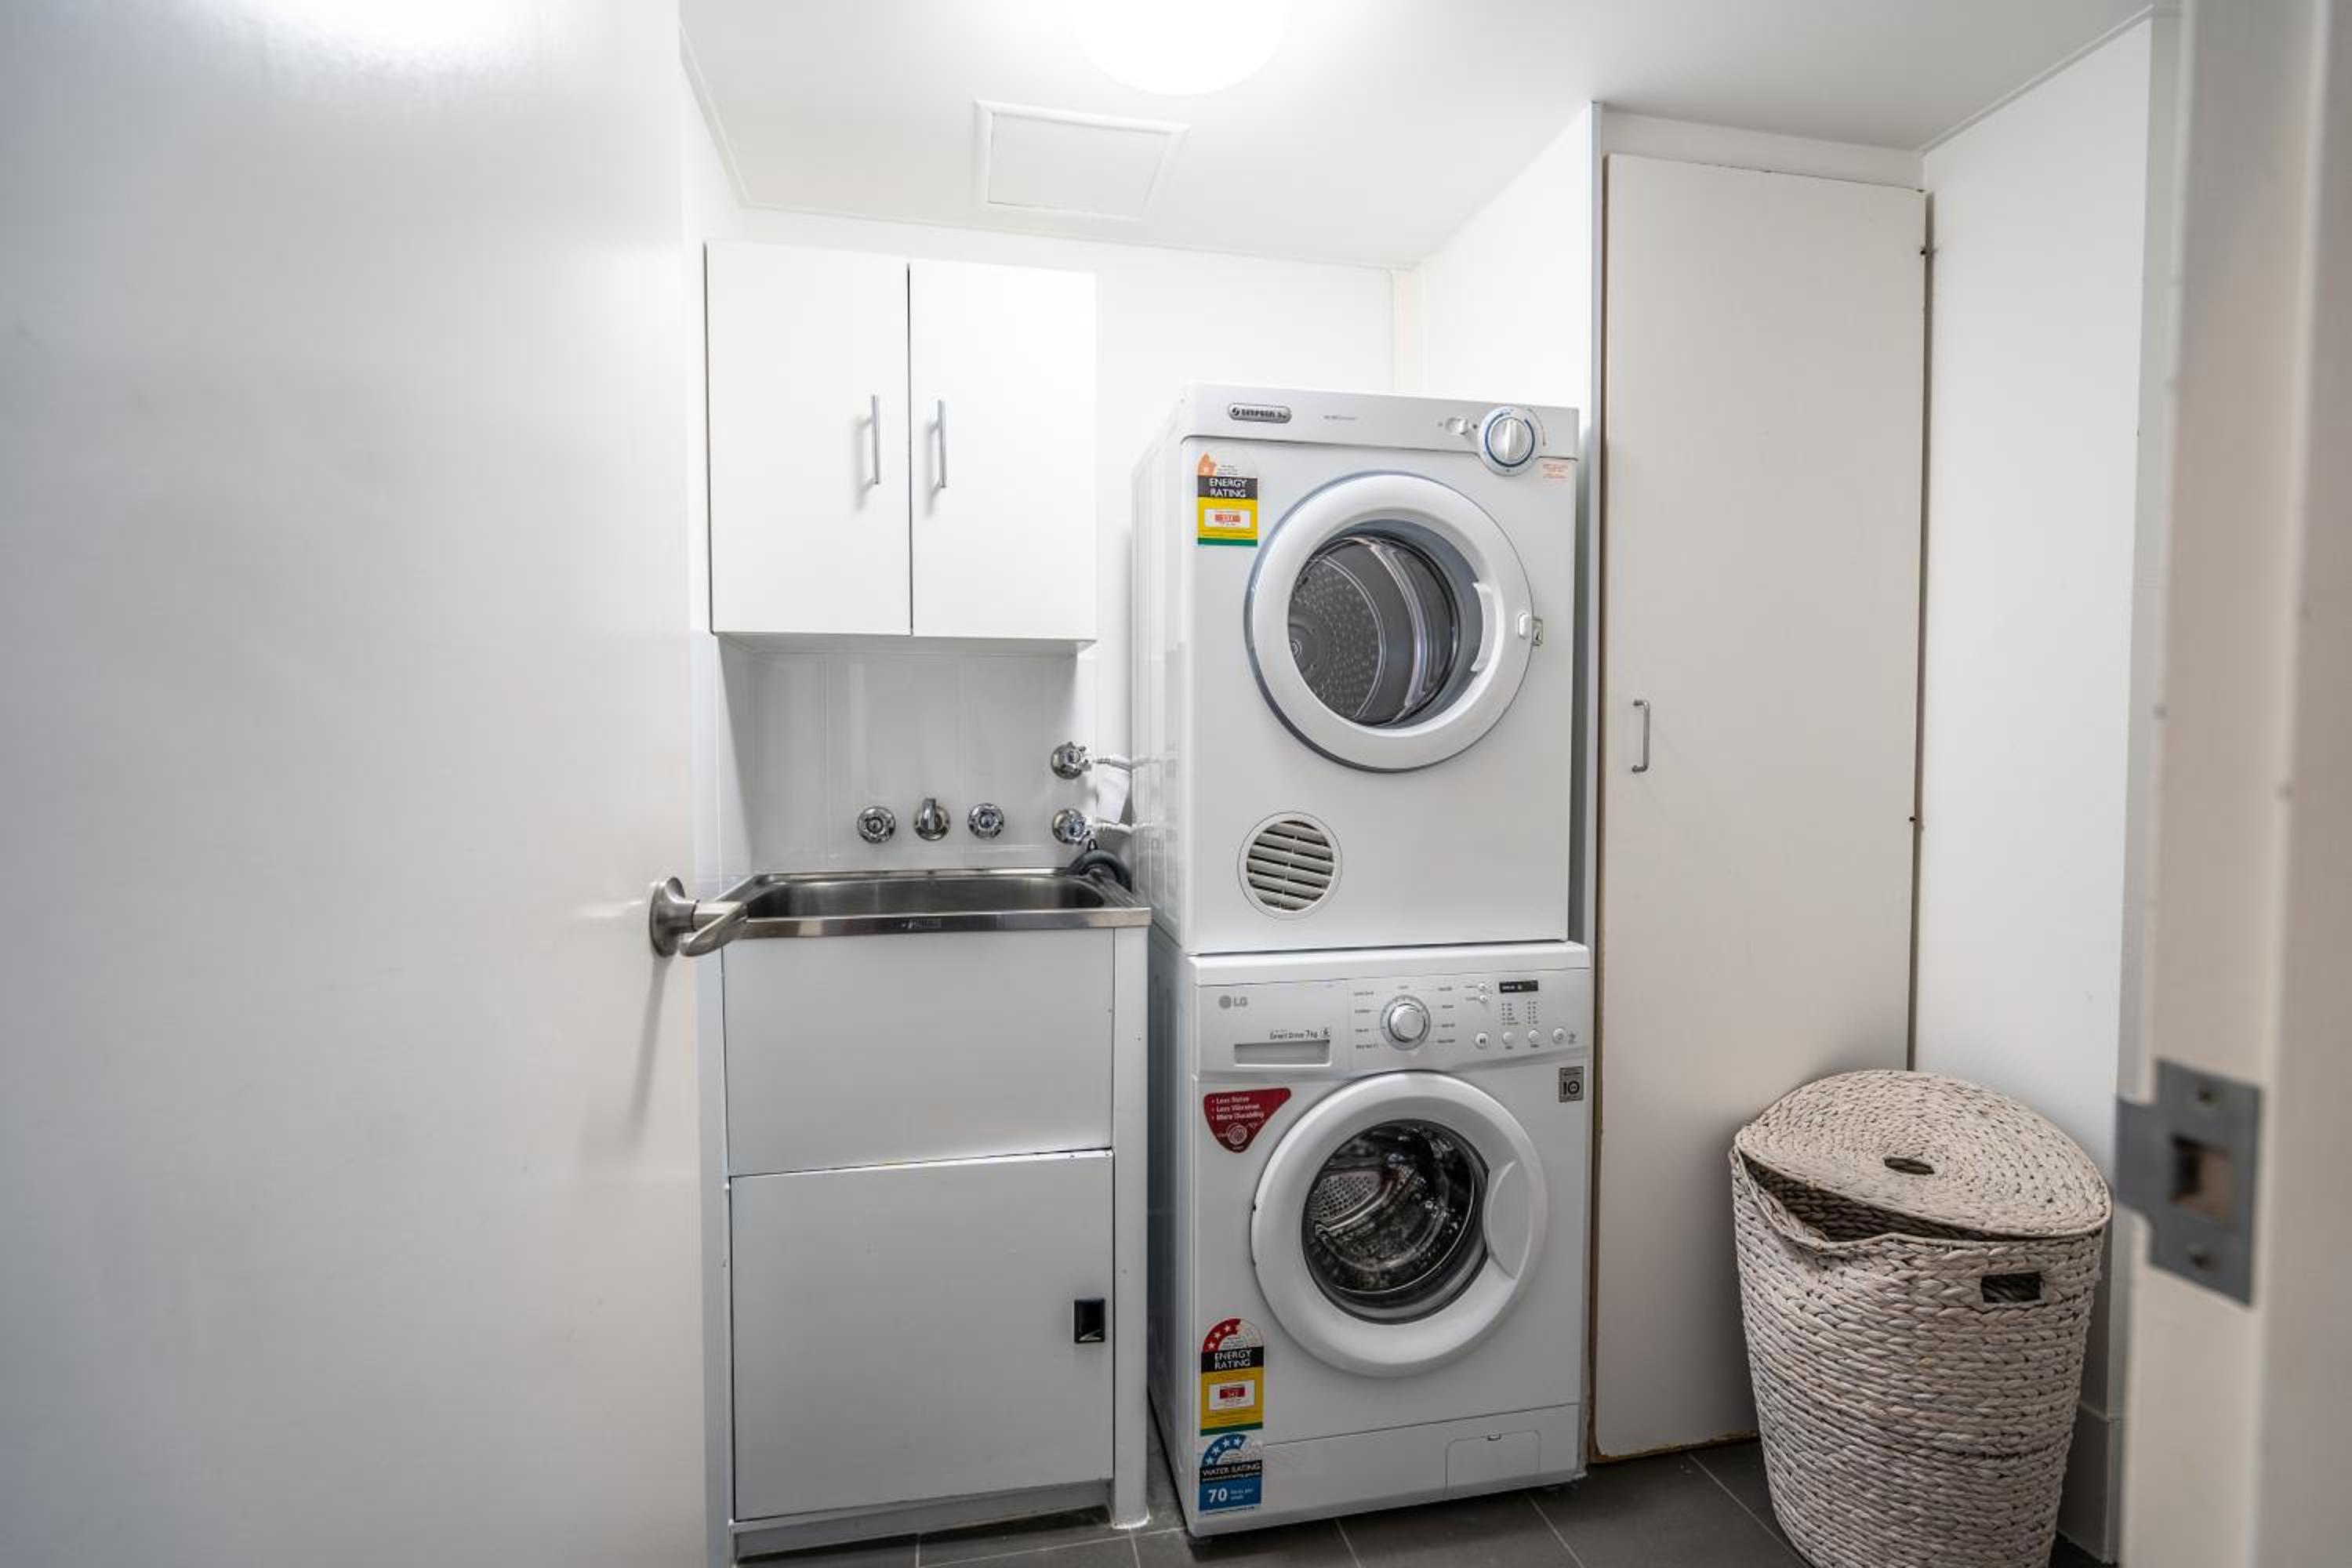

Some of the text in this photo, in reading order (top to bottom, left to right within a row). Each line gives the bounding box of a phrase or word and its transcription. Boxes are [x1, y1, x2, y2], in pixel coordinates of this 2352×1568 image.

[1209, 477, 1247, 488] ENERGY
[1210, 488, 1247, 498] RATING
[1233, 996, 1248, 1007] LG
[1214, 1349, 1252, 1360] ENERGY
[1214, 1359, 1251, 1370] RATING
[1208, 1487, 1229, 1504] 70
